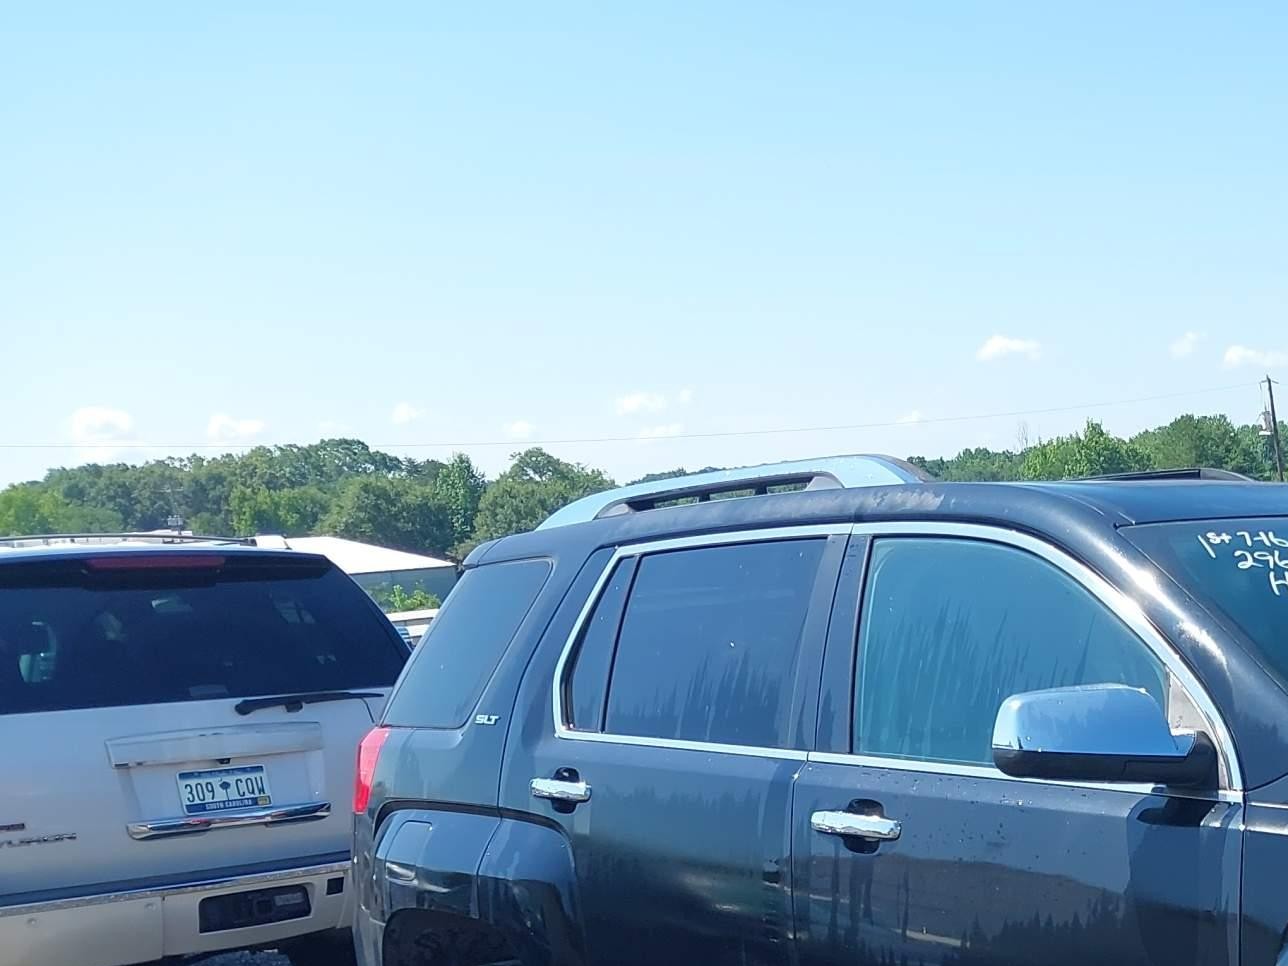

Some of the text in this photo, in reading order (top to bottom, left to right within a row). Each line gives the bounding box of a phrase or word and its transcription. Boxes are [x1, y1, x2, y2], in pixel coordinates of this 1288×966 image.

[474, 713, 501, 726] SLT
[184, 776, 267, 803] 309 CQW
